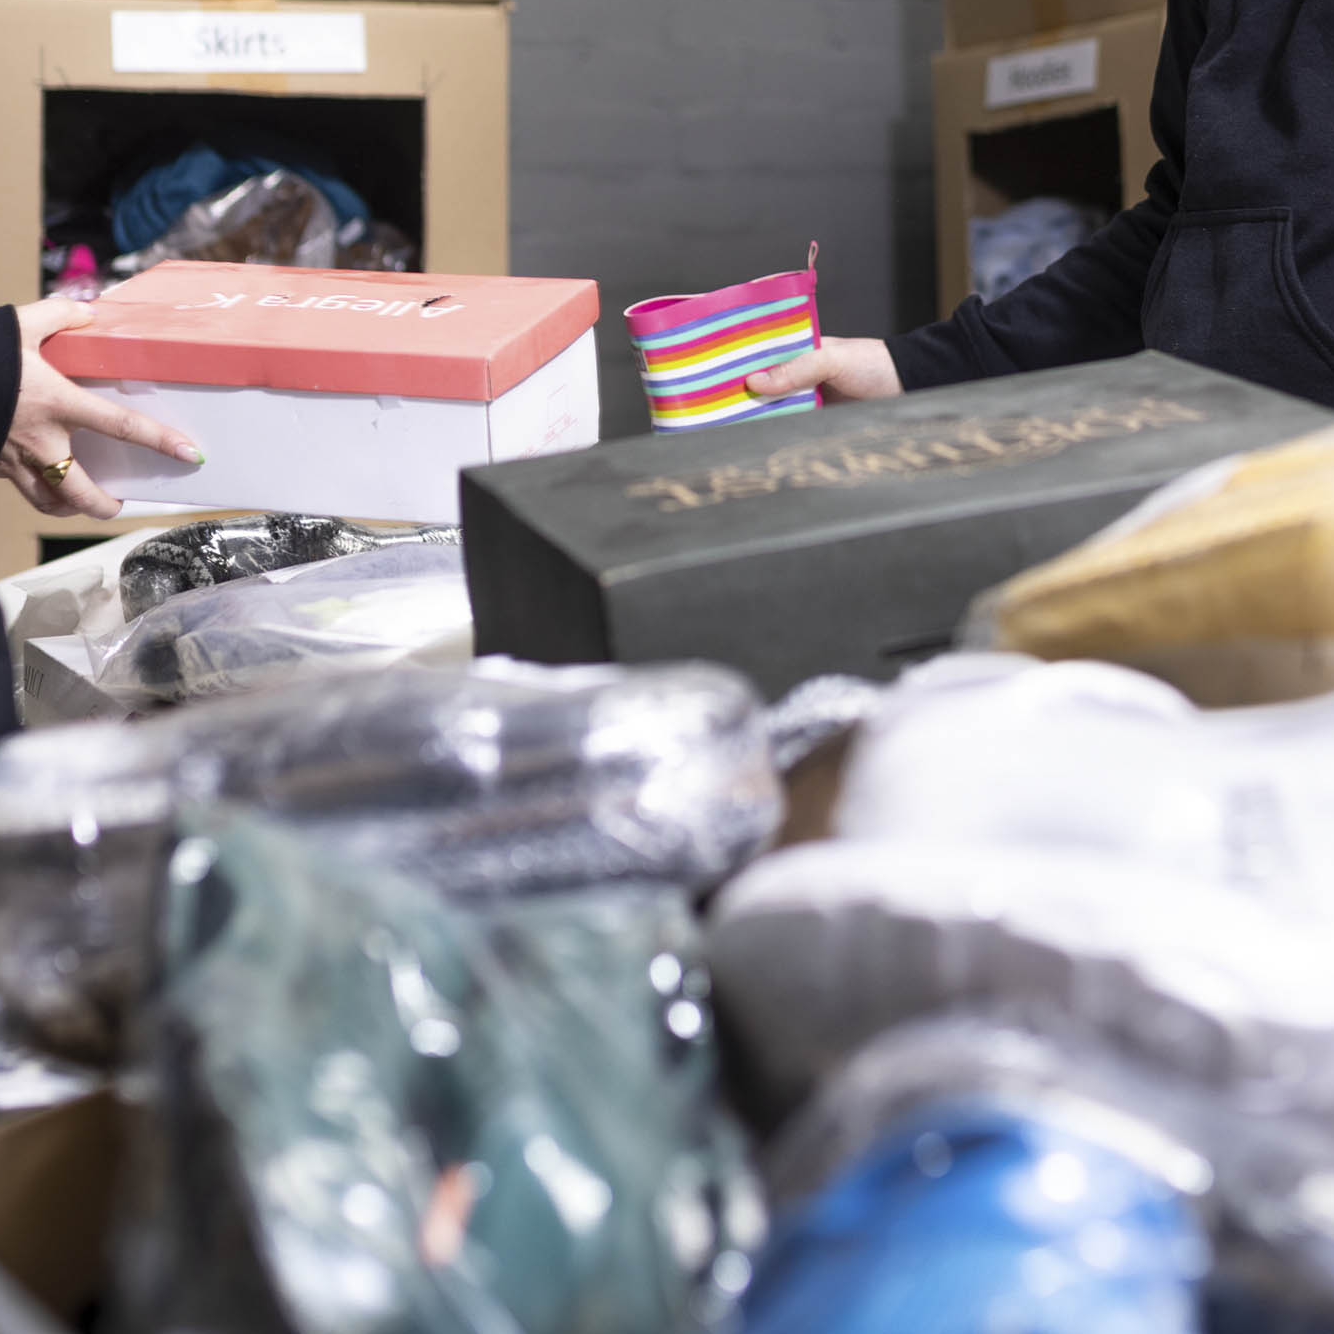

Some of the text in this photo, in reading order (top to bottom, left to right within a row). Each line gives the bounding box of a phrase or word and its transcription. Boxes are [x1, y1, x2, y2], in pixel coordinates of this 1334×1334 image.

[193, 27, 287, 57] Skirts
[174, 292, 464, 318] Allegra K
